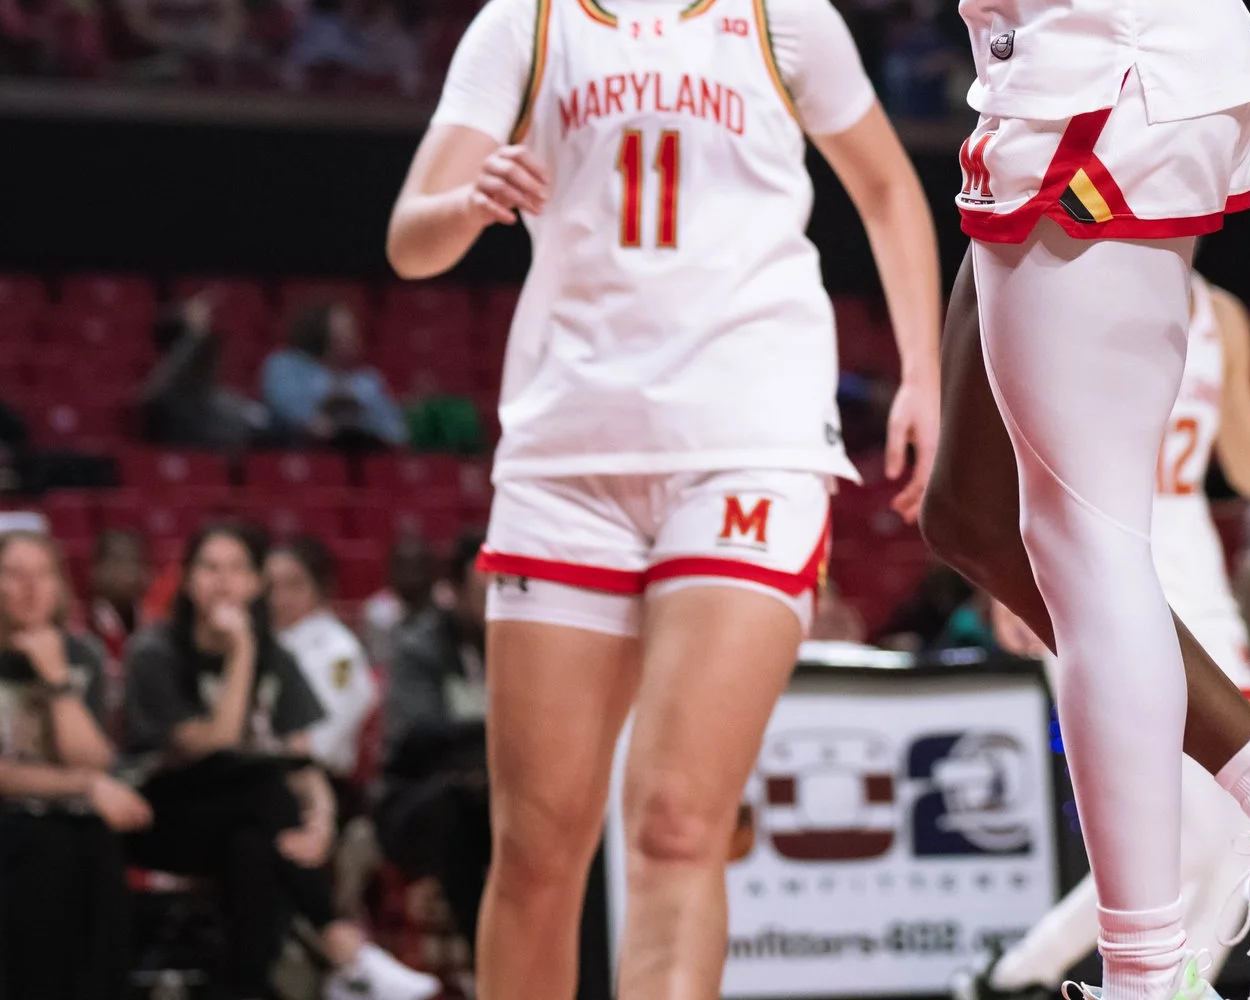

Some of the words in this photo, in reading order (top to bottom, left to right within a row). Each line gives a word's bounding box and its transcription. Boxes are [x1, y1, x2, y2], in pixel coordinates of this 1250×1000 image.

[558, 72, 745, 139] MARYLAND
[617, 129, 679, 249] 11
[719, 495, 773, 544] M
